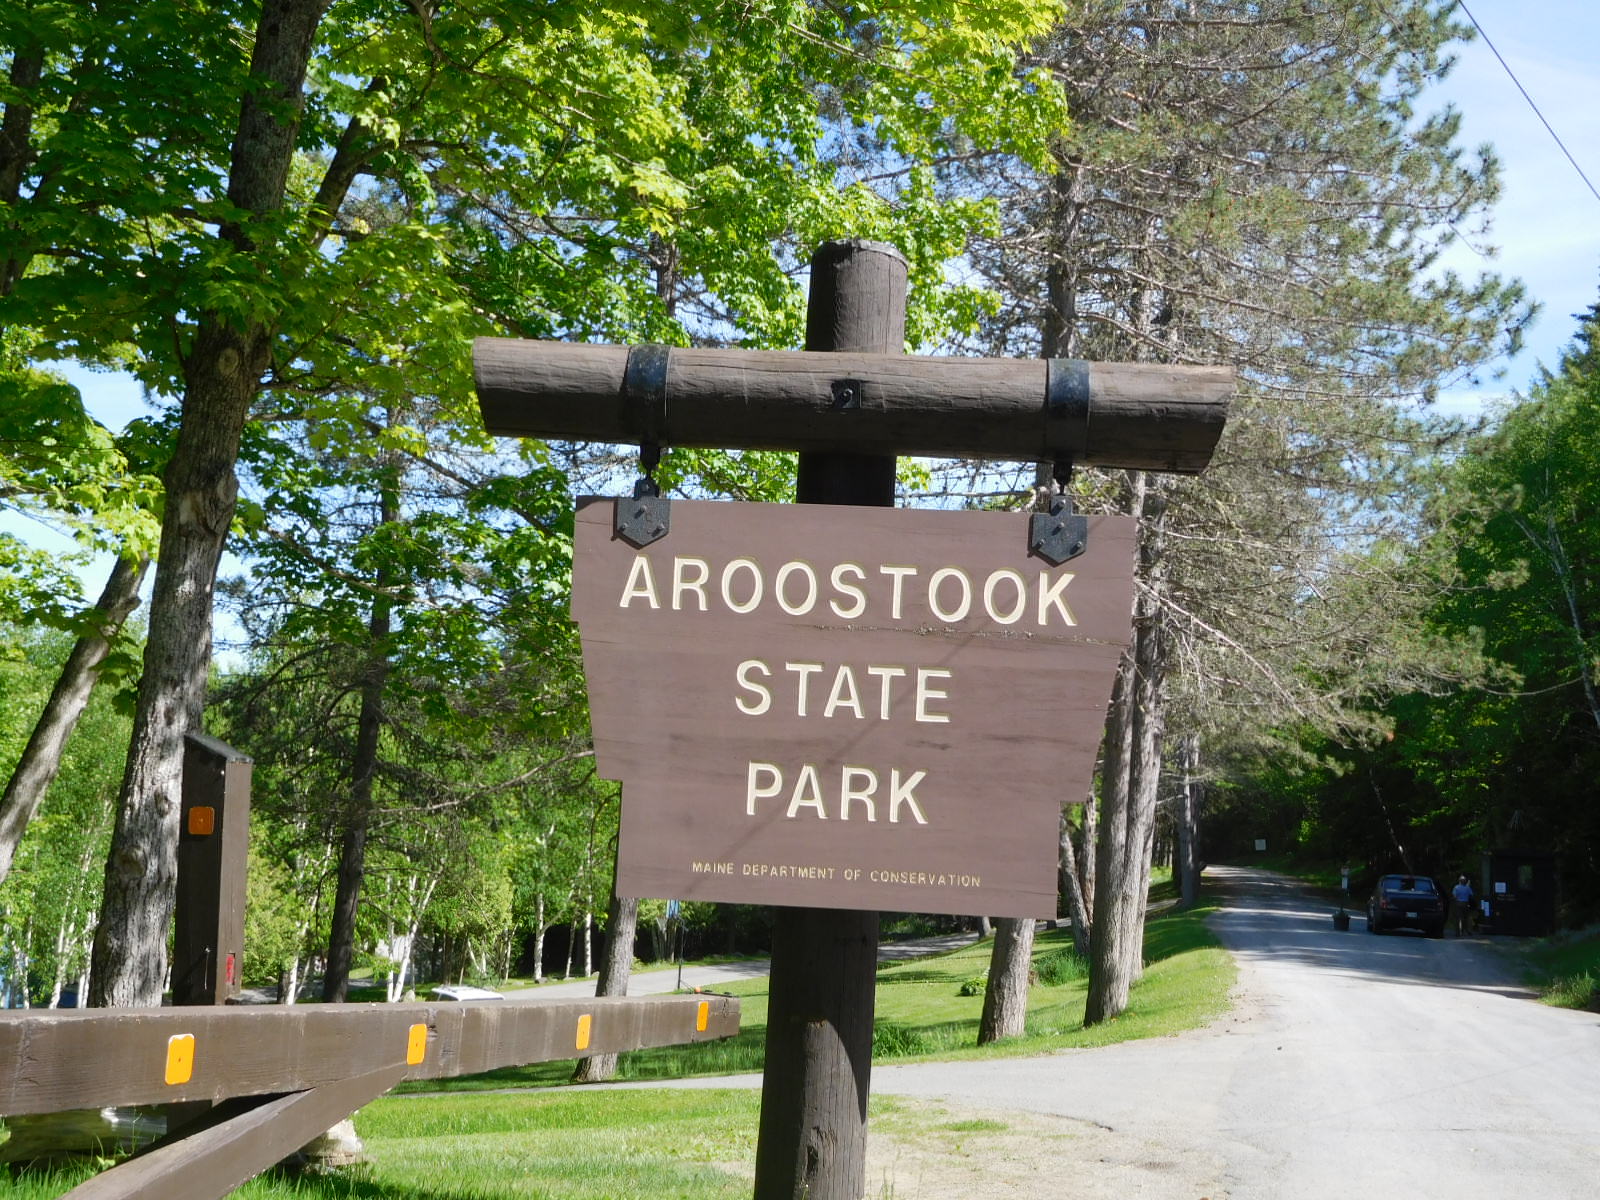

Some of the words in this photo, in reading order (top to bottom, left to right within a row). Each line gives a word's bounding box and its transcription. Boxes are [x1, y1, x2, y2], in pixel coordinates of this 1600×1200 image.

[619, 554, 1077, 627] AROOSTOOK
[735, 659, 952, 723] STATE
[746, 760, 928, 825] PARK
[692, 861, 734, 875] MAINE
[742, 863, 835, 880] DEPARTMENT
[844, 868, 861, 881] OF
[870, 870, 981, 888] CONSERVATION
